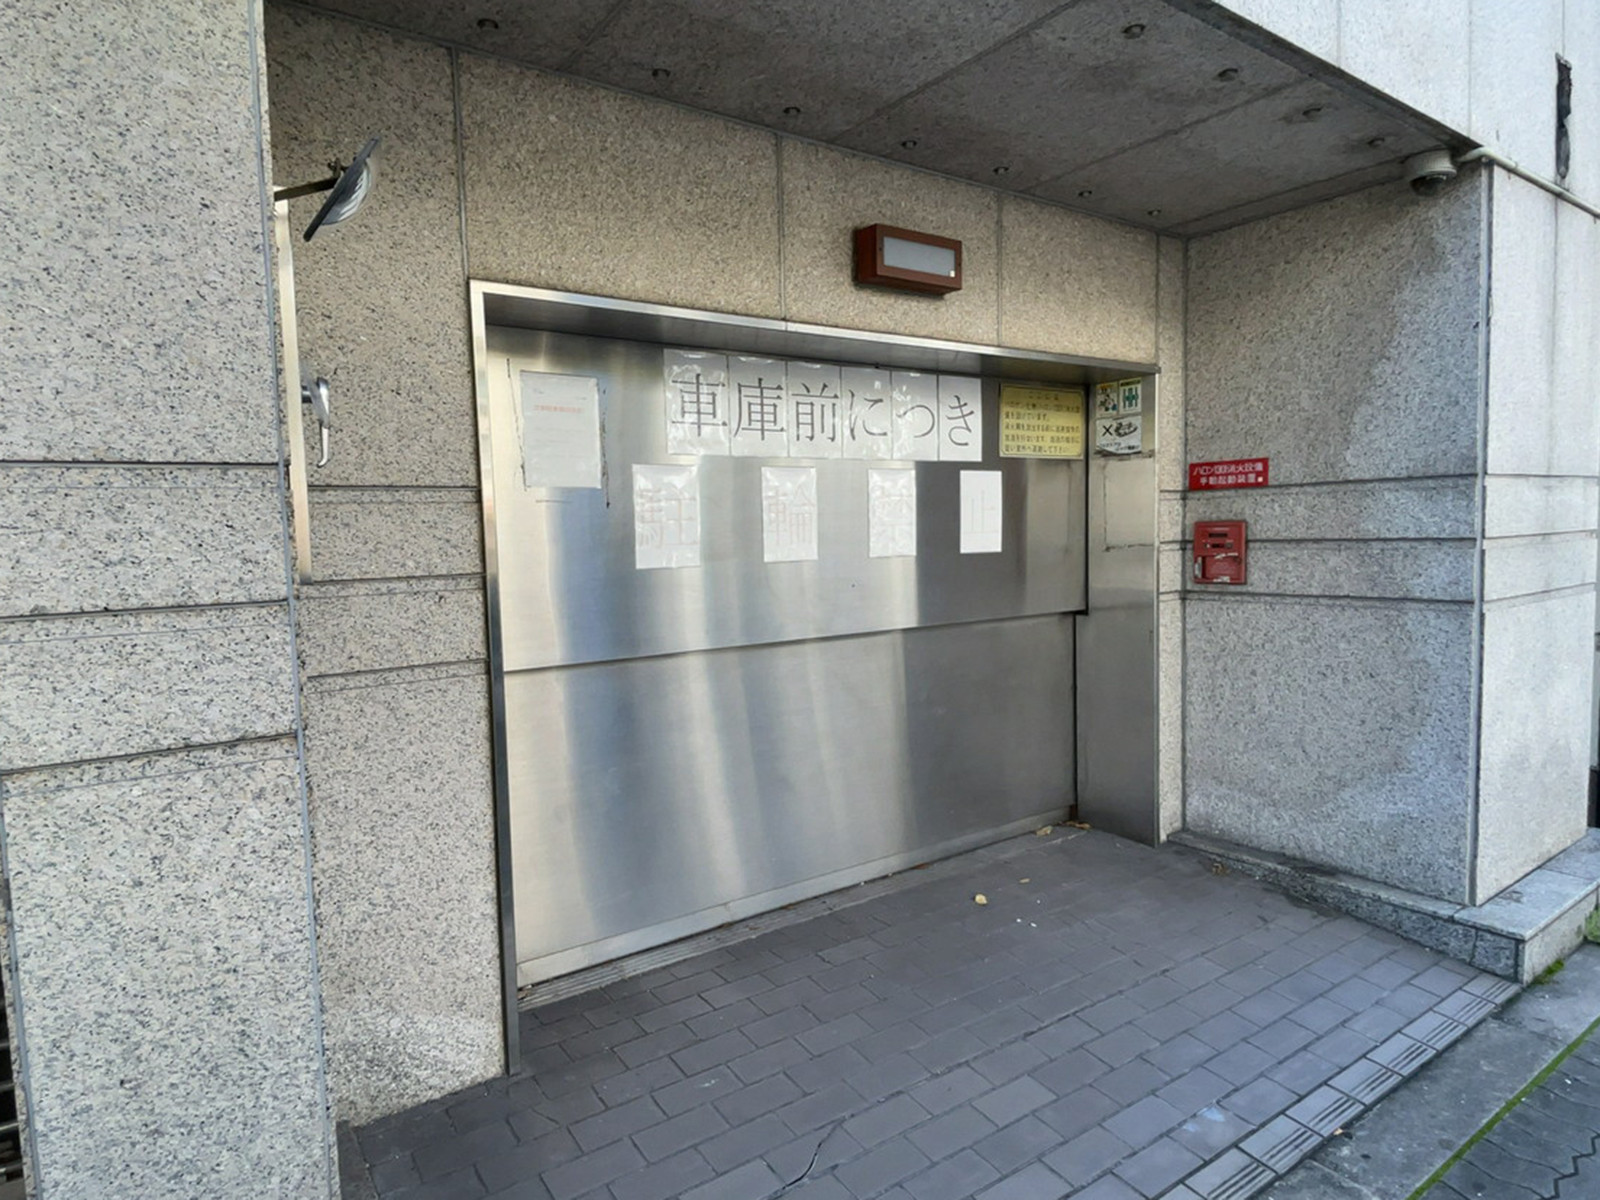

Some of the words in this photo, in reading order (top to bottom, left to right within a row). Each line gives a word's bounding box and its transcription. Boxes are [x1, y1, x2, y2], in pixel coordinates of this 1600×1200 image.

[671, 373, 975, 447] 車庫前につき
